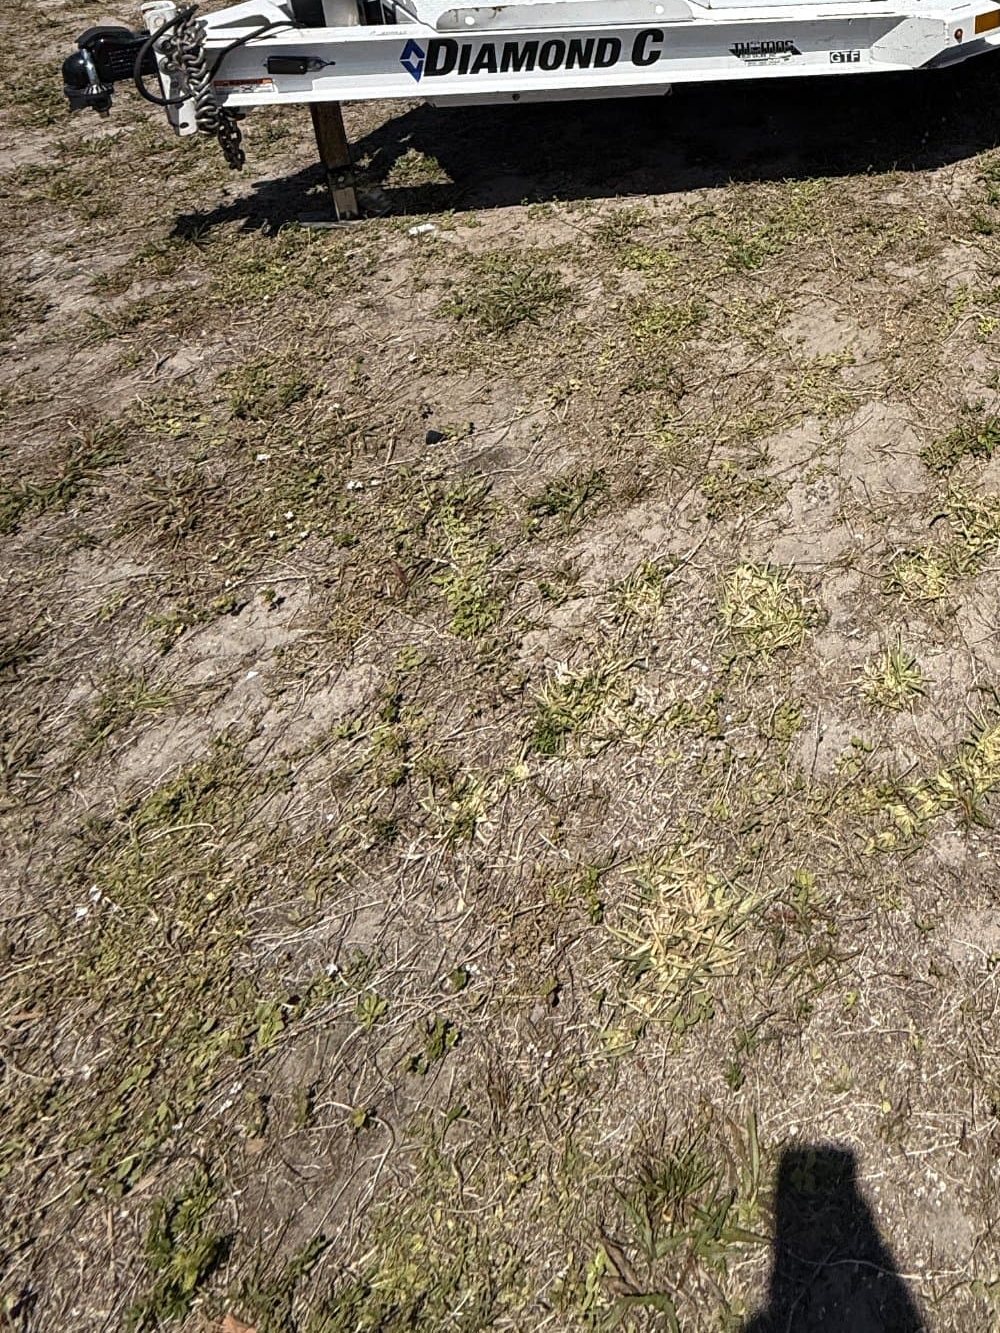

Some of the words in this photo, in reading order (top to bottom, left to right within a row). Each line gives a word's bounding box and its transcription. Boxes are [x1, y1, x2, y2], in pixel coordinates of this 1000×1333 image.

[423, 37, 622, 77] DIAMOND
[631, 27, 665, 67] C
[831, 51, 859, 63] GTF
